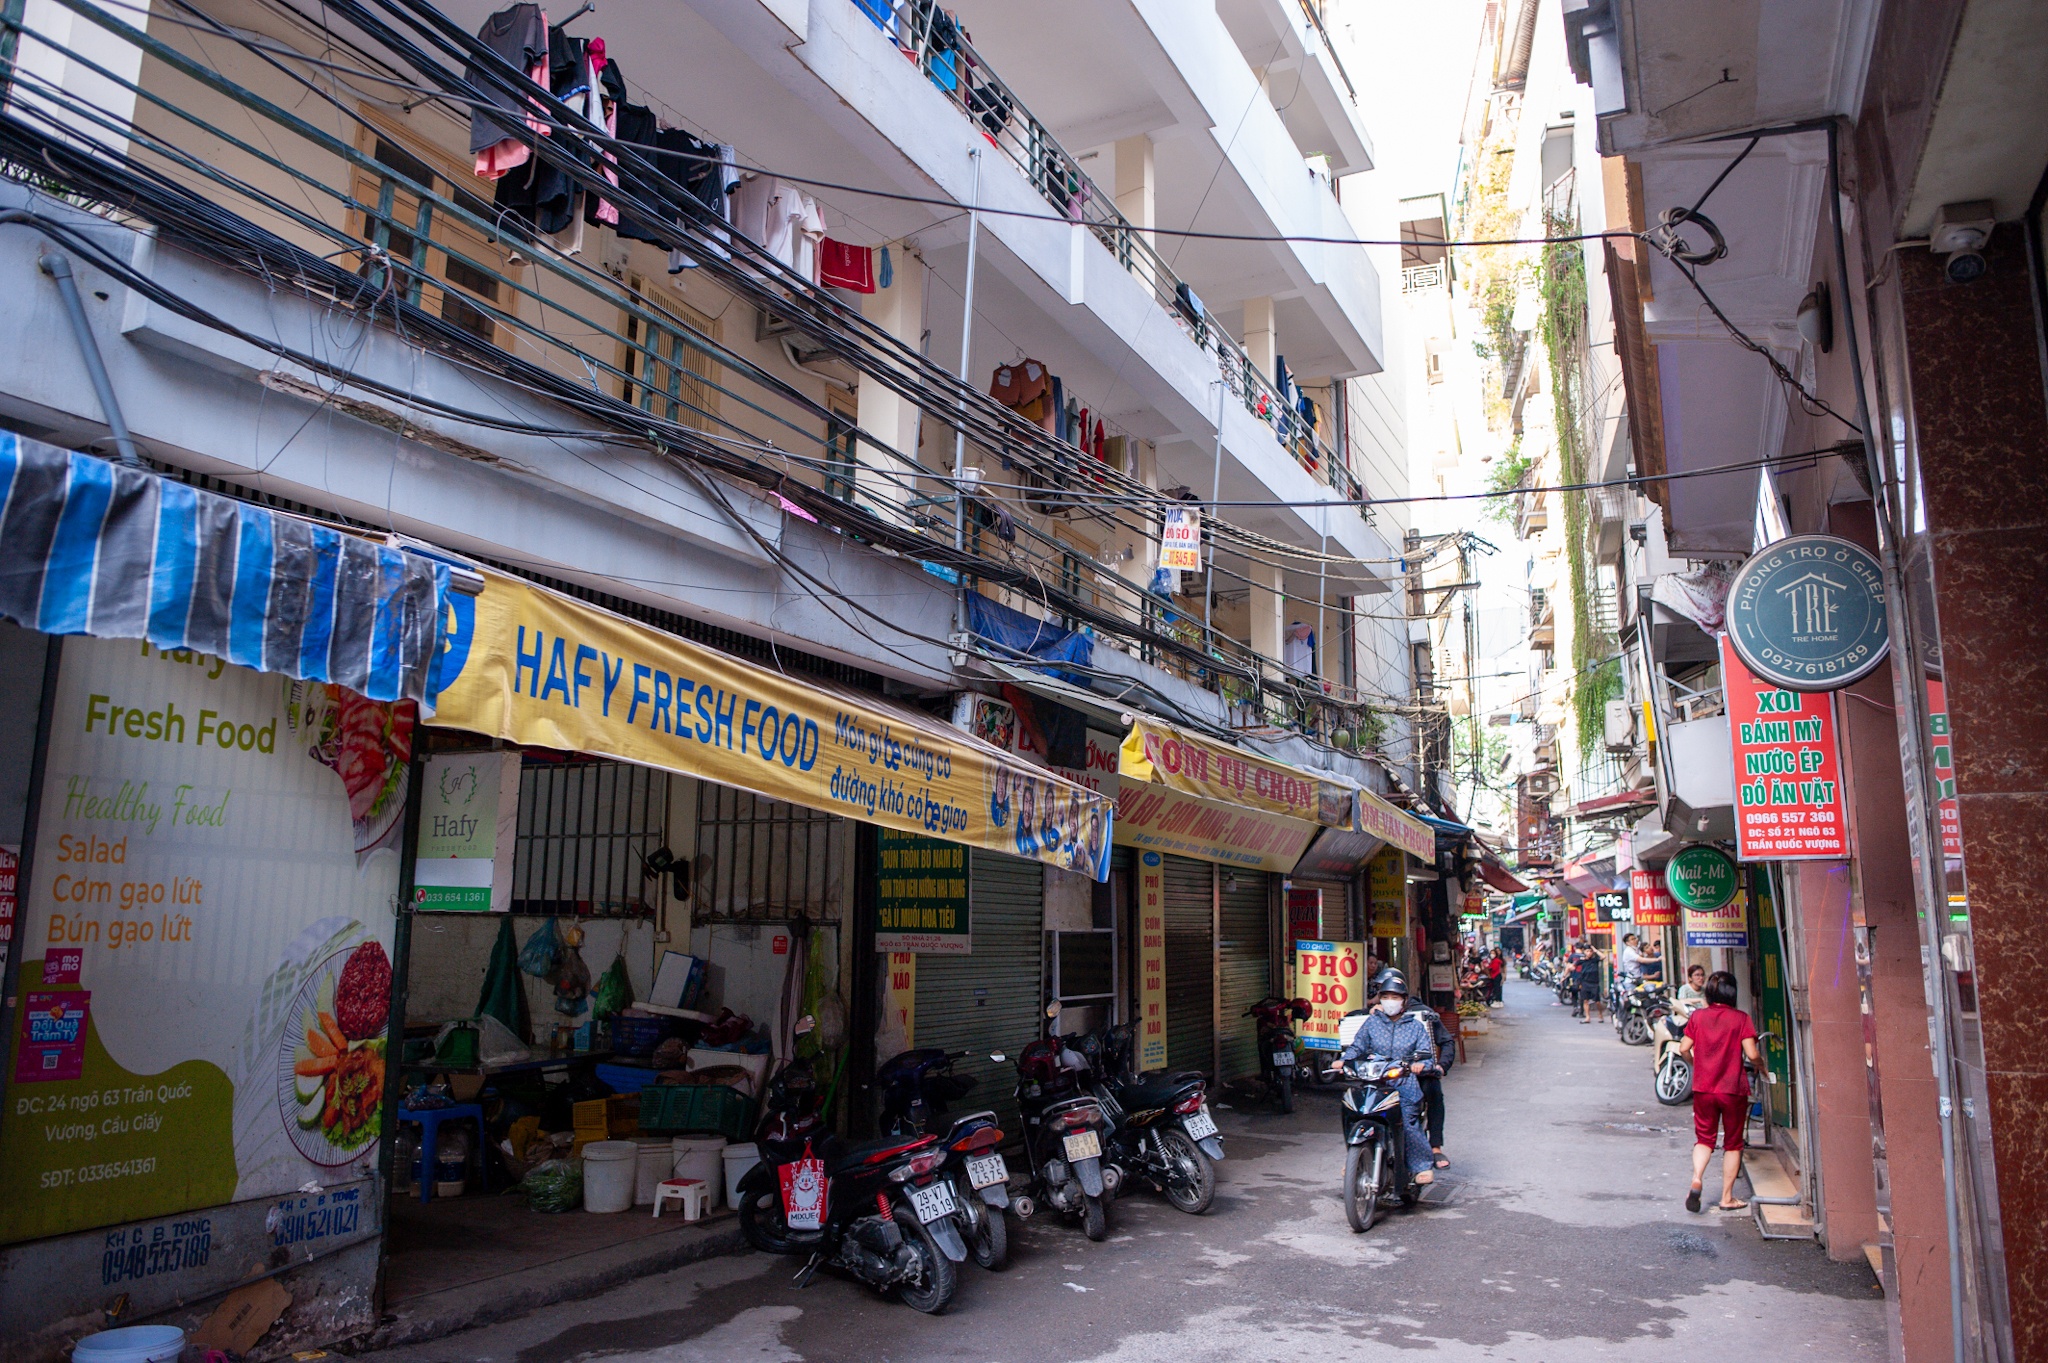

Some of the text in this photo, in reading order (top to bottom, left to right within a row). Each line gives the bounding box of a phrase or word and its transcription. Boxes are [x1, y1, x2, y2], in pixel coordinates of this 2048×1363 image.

[1741, 556, 1782, 610] PHÒNG
[1786, 546, 1827, 560] TRỌ
[1761, 644, 1868, 675] 0927618789
[513, 625, 623, 718] HAFY
[627, 662, 738, 751] FRESH
[741, 699, 819, 771] FOOD
[85, 694, 277, 754] Fresh Food
[1741, 716, 1822, 744] BÁNH MỲ
[835, 711, 866, 752] Món
[903, 737, 933, 781] cũng
[937, 748, 951, 779] có
[1145, 732, 1312, 811] CƠM TỰ CHỌN
[1746, 747, 1823, 774] NƯỚC ÉP
[63, 774, 231, 835] Healthy Food
[830, 765, 877, 816] đường
[879, 777, 904, 814] khó
[907, 787, 923, 819] có
[941, 797, 967, 834] giao
[1741, 777, 1834, 808] ĐỒ ĂN VẶT
[432, 814, 479, 842] Hafy
[1746, 812, 1835, 824] 0966 557 360
[1768, 826, 1781, 837] SỐ
[1784, 828, 1795, 836] 21
[1798, 826, 1820, 836] NGÕ
[1822, 827, 1835, 836] 63
[57, 834, 127, 864] Salad
[1746, 837, 1840, 850] TRẦN QUỐC VƯỢNG
[933, 849, 950, 868] NAM
[52, 874, 202, 910] Cơm gạo lứt
[1633, 873, 1654, 892] GIẶT
[1688, 882, 1716, 898] Spa
[426, 892, 485, 902] 033 654 1361
[1598, 894, 1622, 907] TÓC
[1639, 894, 1652, 910] LÀ
[47, 912, 193, 949] Bún gạo lứt
[922, 909, 937, 928] HOA
[1653, 913, 1675, 923] NGAY
[1144, 935, 1162, 948] RANG
[1301, 947, 1358, 978] PHỞ
[1311, 978, 1348, 1005] BÒ
[16, 1080, 193, 1115] ĐC: 24 ngõ 63 Trần Quốc
[101, 1115, 129, 1135] Cầu
[133, 1112, 163, 1133] Giấy
[40, 1157, 156, 1189] SĐT: 0336541361
[977, 1169, 1004, 1185] 4575
[917, 1185, 943, 1207] 29-V7
[919, 1198, 953, 1221] 279.19
